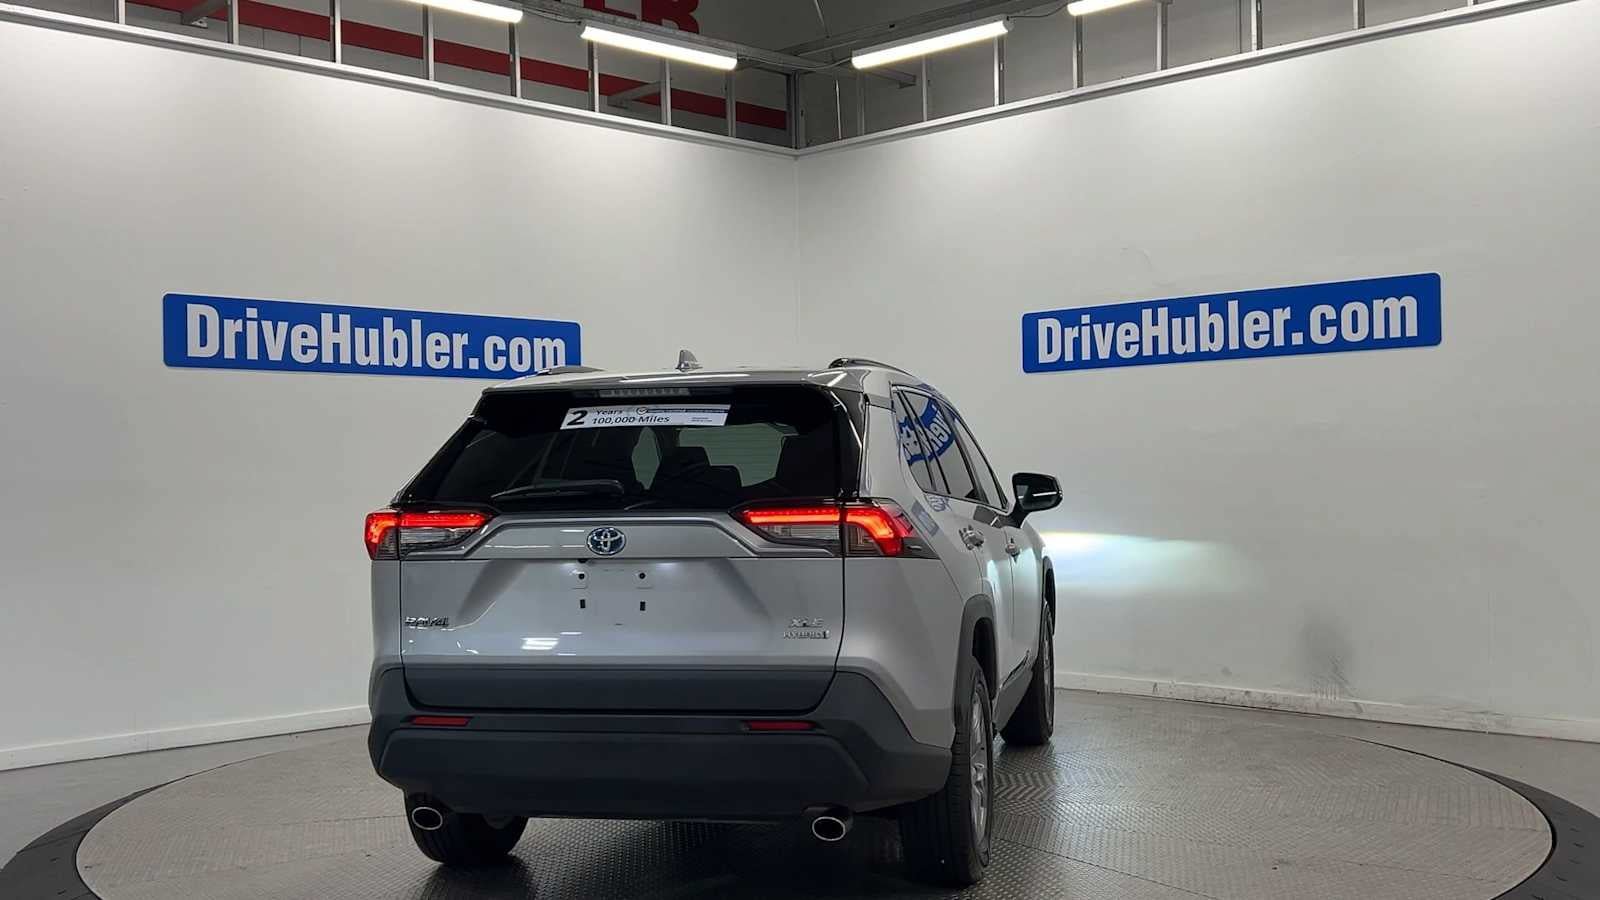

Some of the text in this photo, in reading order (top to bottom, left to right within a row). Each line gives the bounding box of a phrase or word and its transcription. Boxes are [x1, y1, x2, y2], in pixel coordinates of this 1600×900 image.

[186, 303, 566, 372] DriveHubler.com
[1037, 294, 1418, 364] DriveHubler.com
[566, 410, 588, 425] 2
[592, 415, 670, 425] 100,000 Miles
